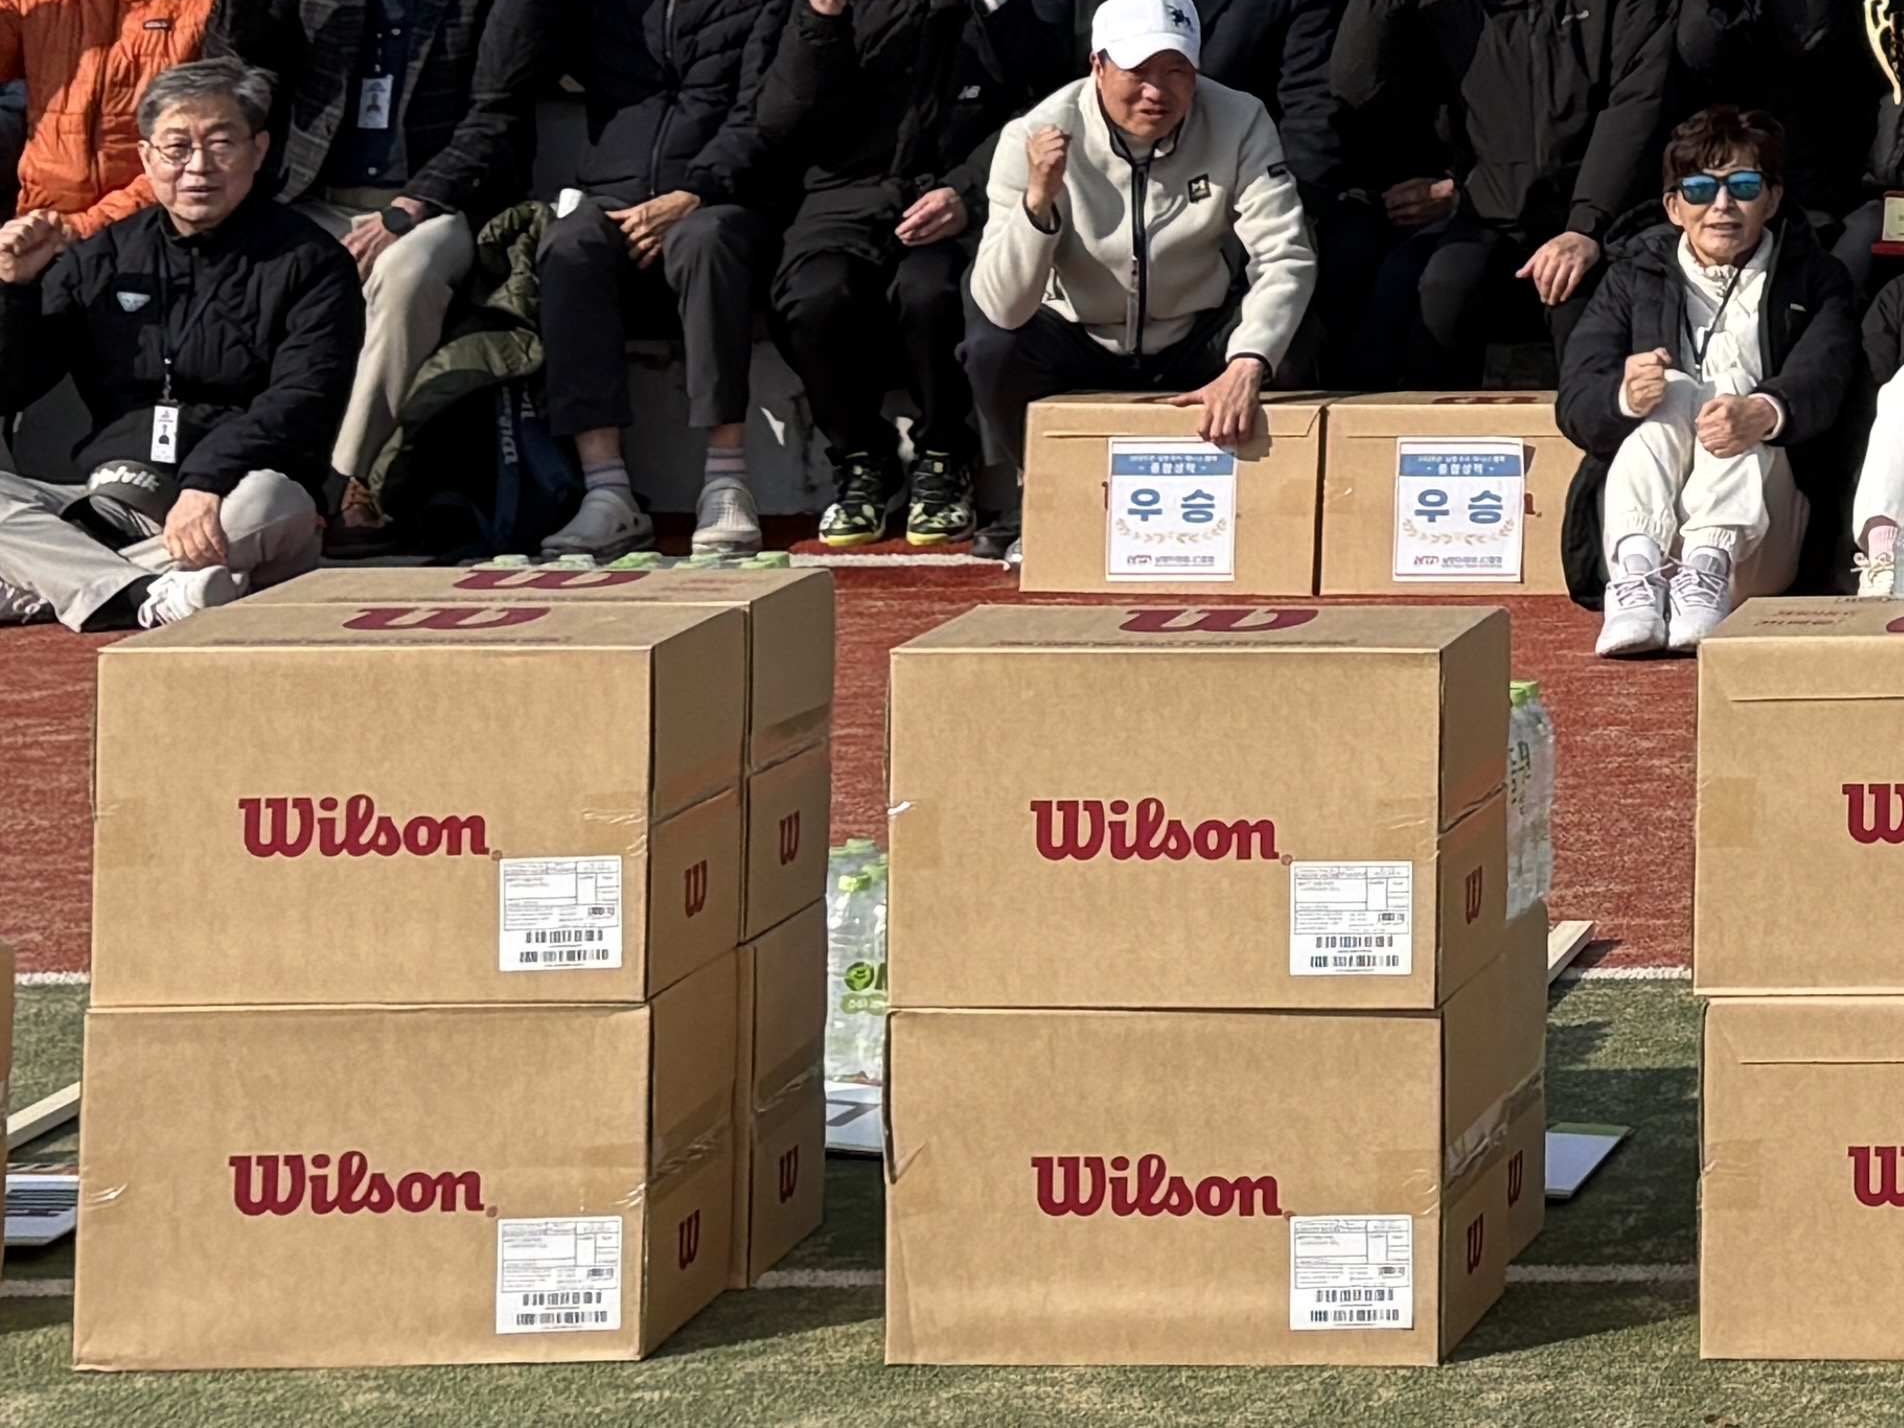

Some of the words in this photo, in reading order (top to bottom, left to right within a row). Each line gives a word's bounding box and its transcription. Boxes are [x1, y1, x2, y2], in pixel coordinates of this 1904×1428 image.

[238, 795, 490, 859] Wilson
[1032, 798, 1281, 862] Wilson
[228, 1151, 486, 1217] Wilson
[1032, 1155, 1282, 1218] Wilson
